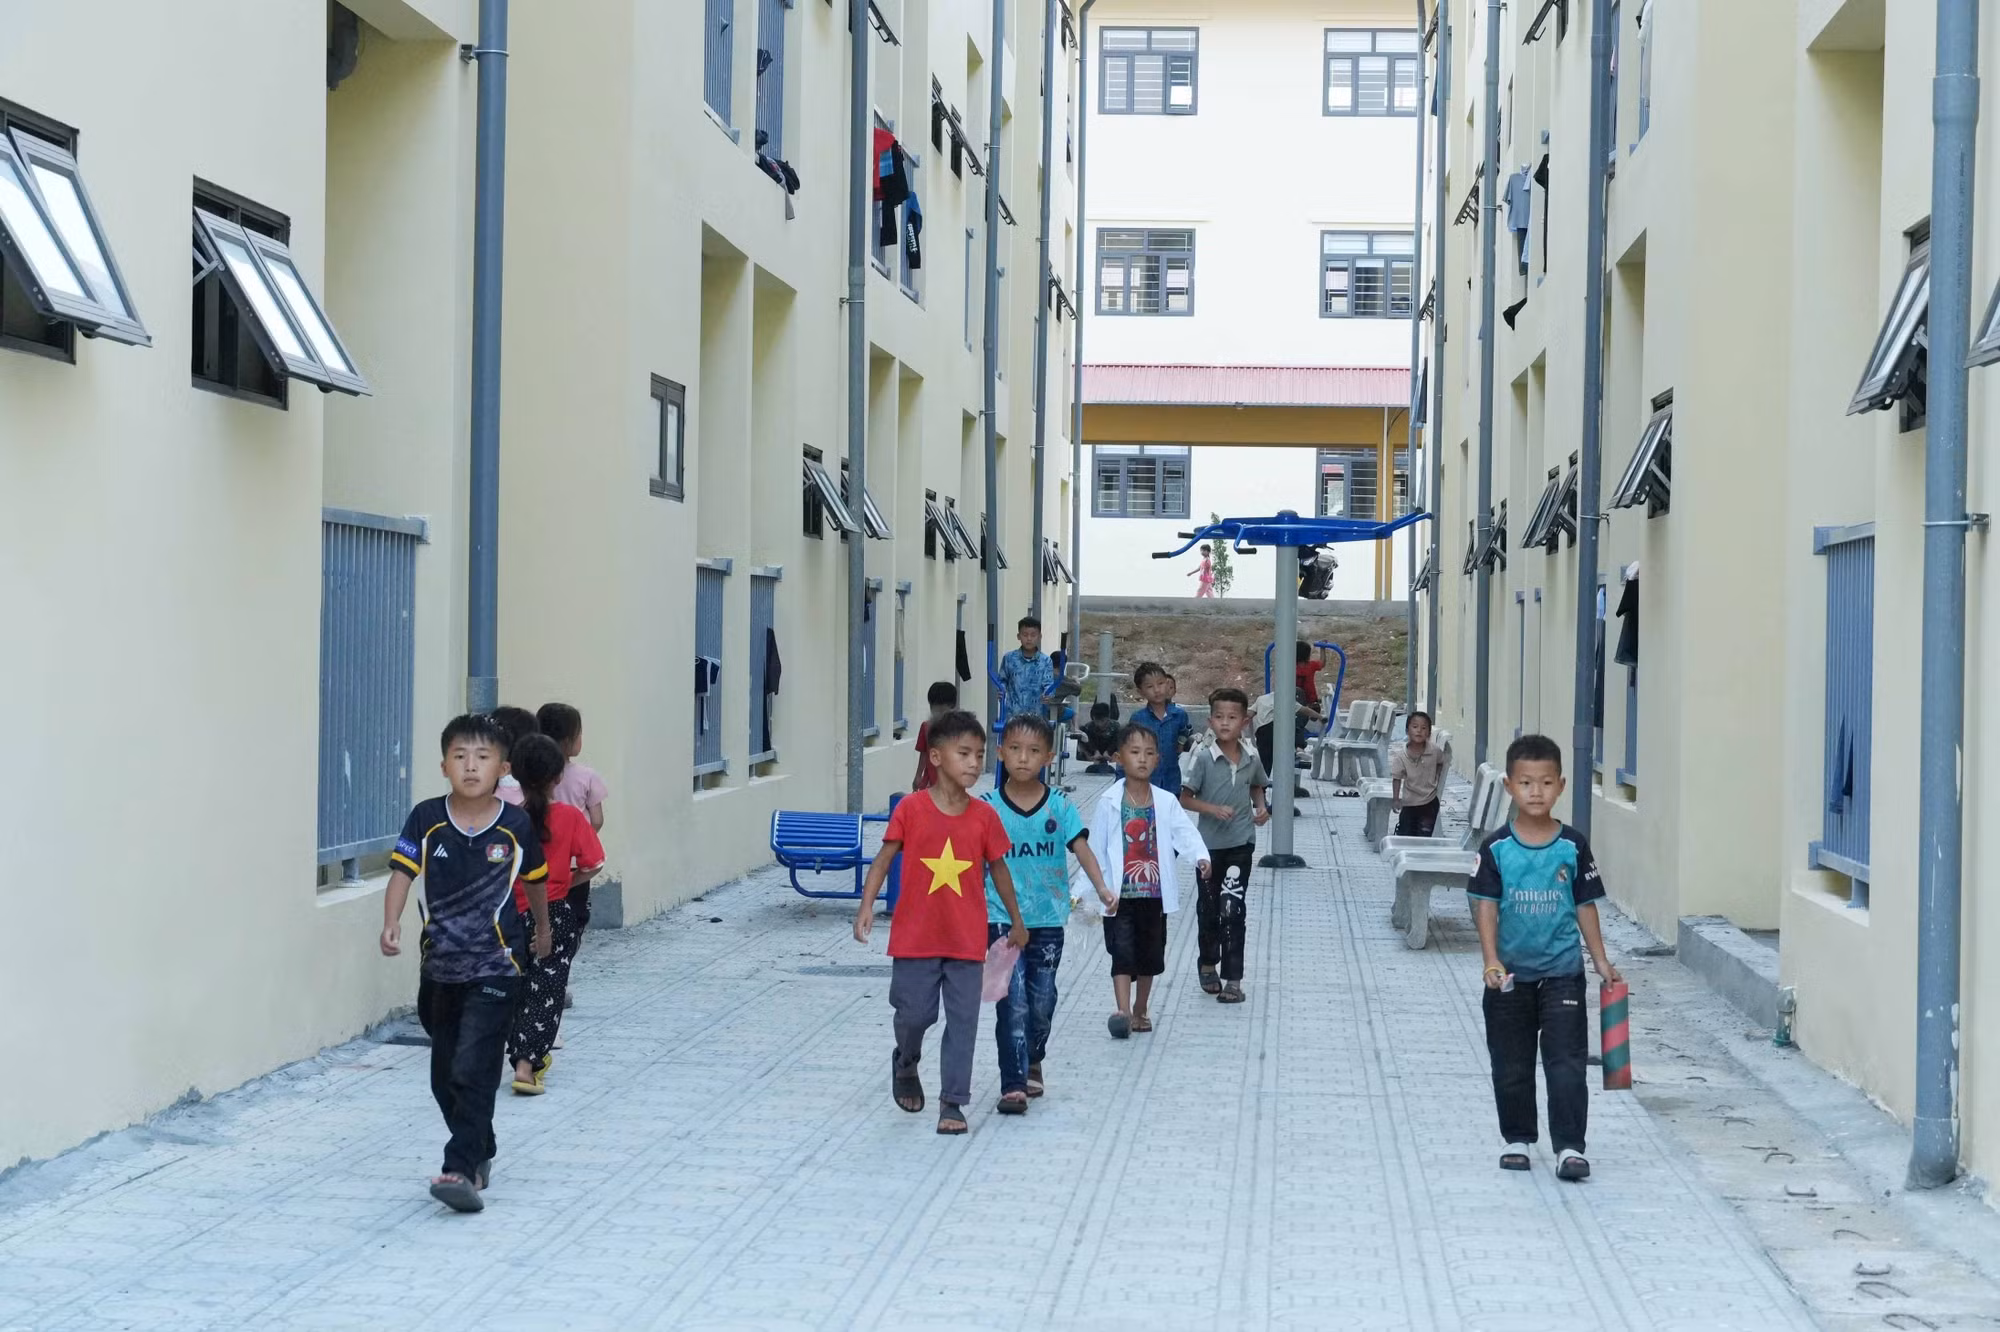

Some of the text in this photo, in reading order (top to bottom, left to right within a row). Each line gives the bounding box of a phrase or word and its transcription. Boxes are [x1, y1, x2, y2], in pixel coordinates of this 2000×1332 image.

[1508, 888, 1563, 901] Emirates
[1515, 902, 1557, 914] FLY BETTER
